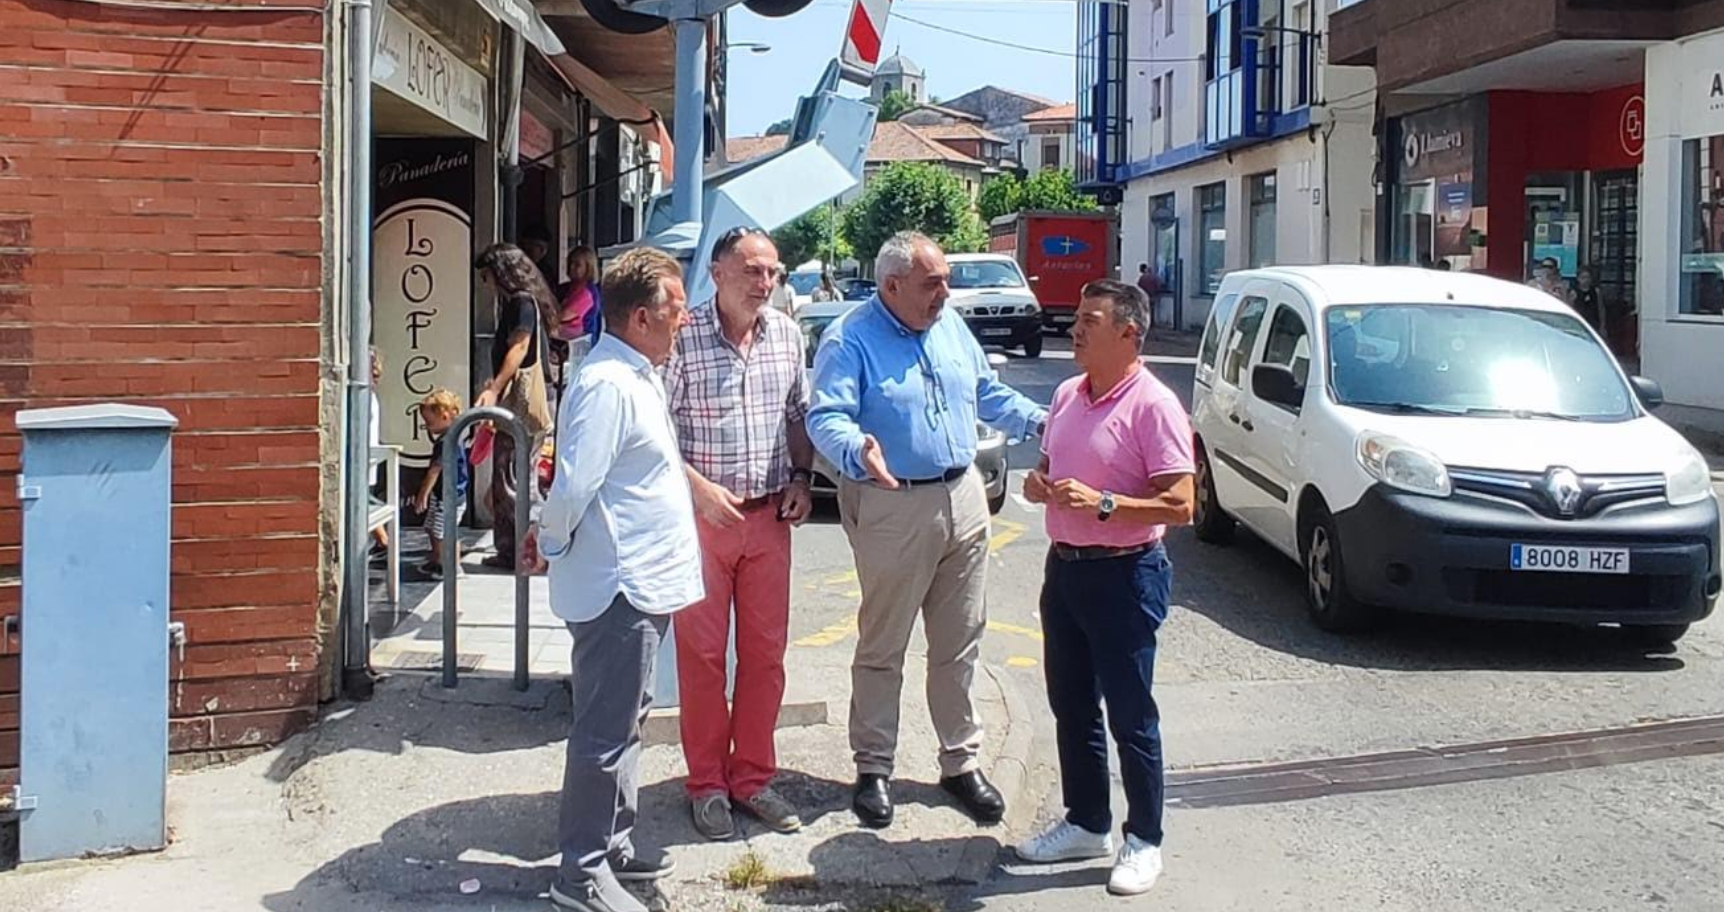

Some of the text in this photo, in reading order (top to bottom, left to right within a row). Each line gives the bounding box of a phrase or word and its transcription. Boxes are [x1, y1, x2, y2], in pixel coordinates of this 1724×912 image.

[379, 151, 469, 187] Panadería
[1527, 548, 1625, 570] 8008 HZF
